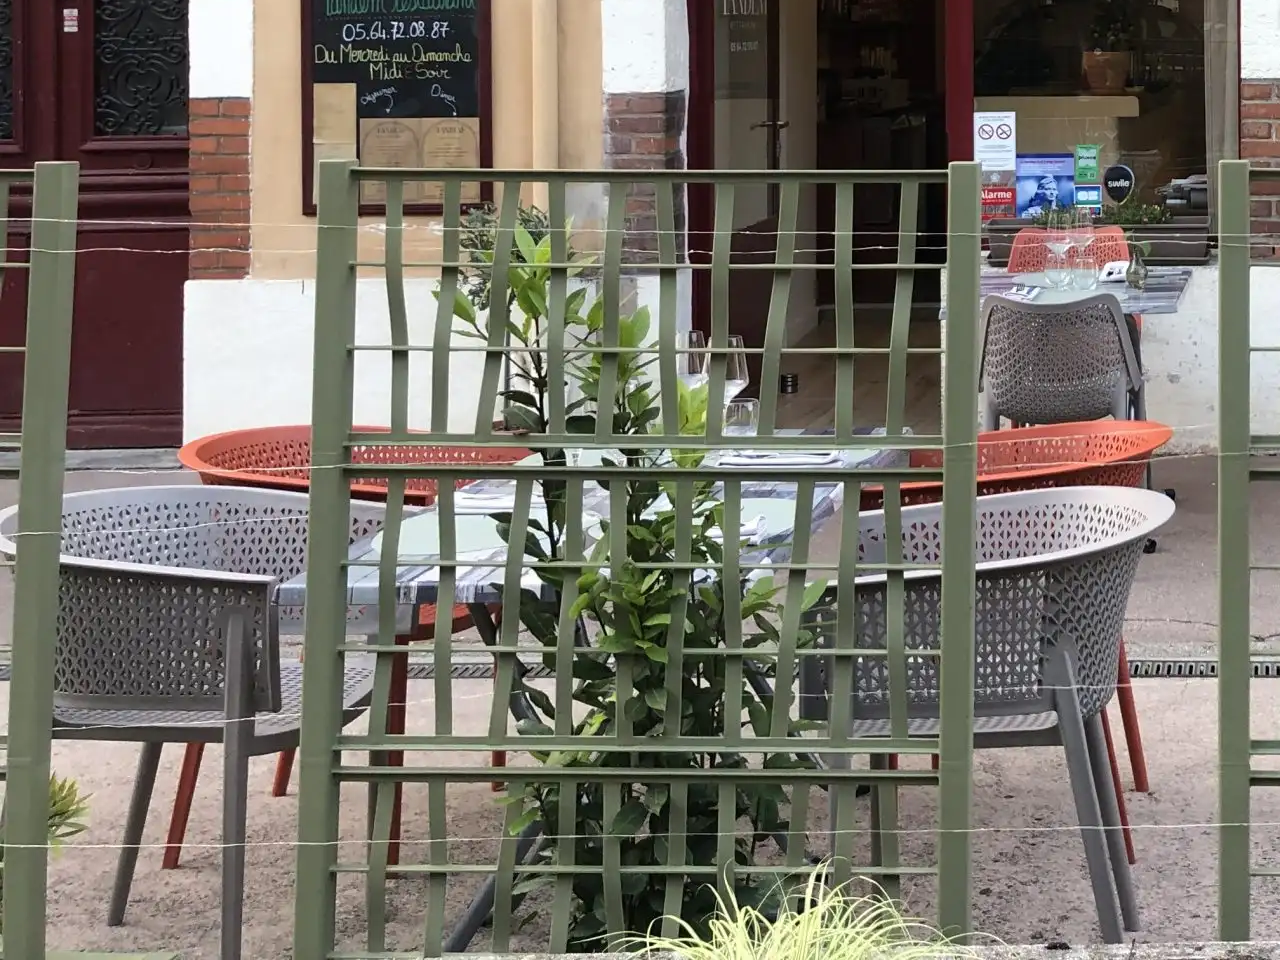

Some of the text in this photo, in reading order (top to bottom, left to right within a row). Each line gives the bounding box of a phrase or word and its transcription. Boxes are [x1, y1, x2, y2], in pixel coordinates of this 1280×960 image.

[314, 43, 472, 63] Du Mercredi au Dimanche
[370, 63, 403, 80] Midi
[415, 62, 452, 79] Soir
